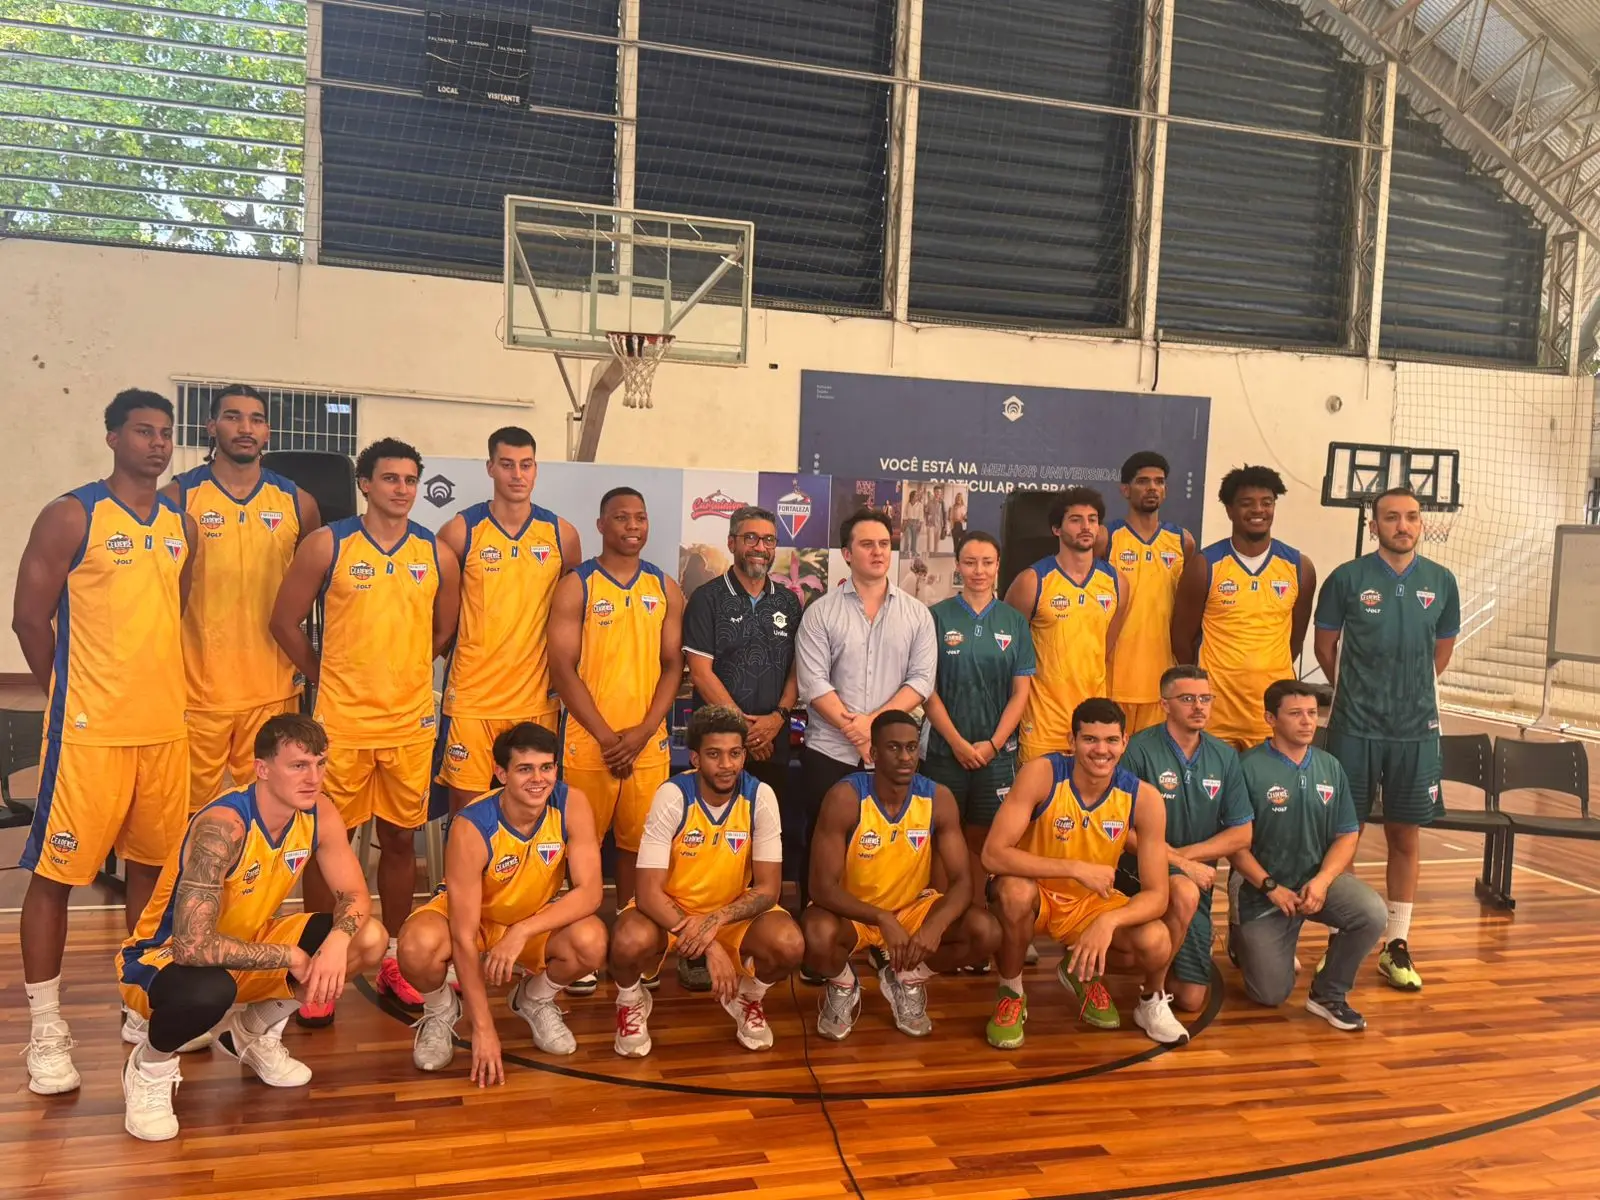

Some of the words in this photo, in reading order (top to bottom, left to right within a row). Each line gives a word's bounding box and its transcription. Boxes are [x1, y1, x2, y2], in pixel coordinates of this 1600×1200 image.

[437, 85, 459, 95] LOCAL
[487, 91, 520, 103] VISITANTE
[880, 456, 919, 472] VOCÊ
[922, 458, 955, 474] ESTÁ
[958, 462, 978, 475] NA
[980, 463, 1038, 478] MELHOR
[778, 505, 810, 513] FORTALEZA
